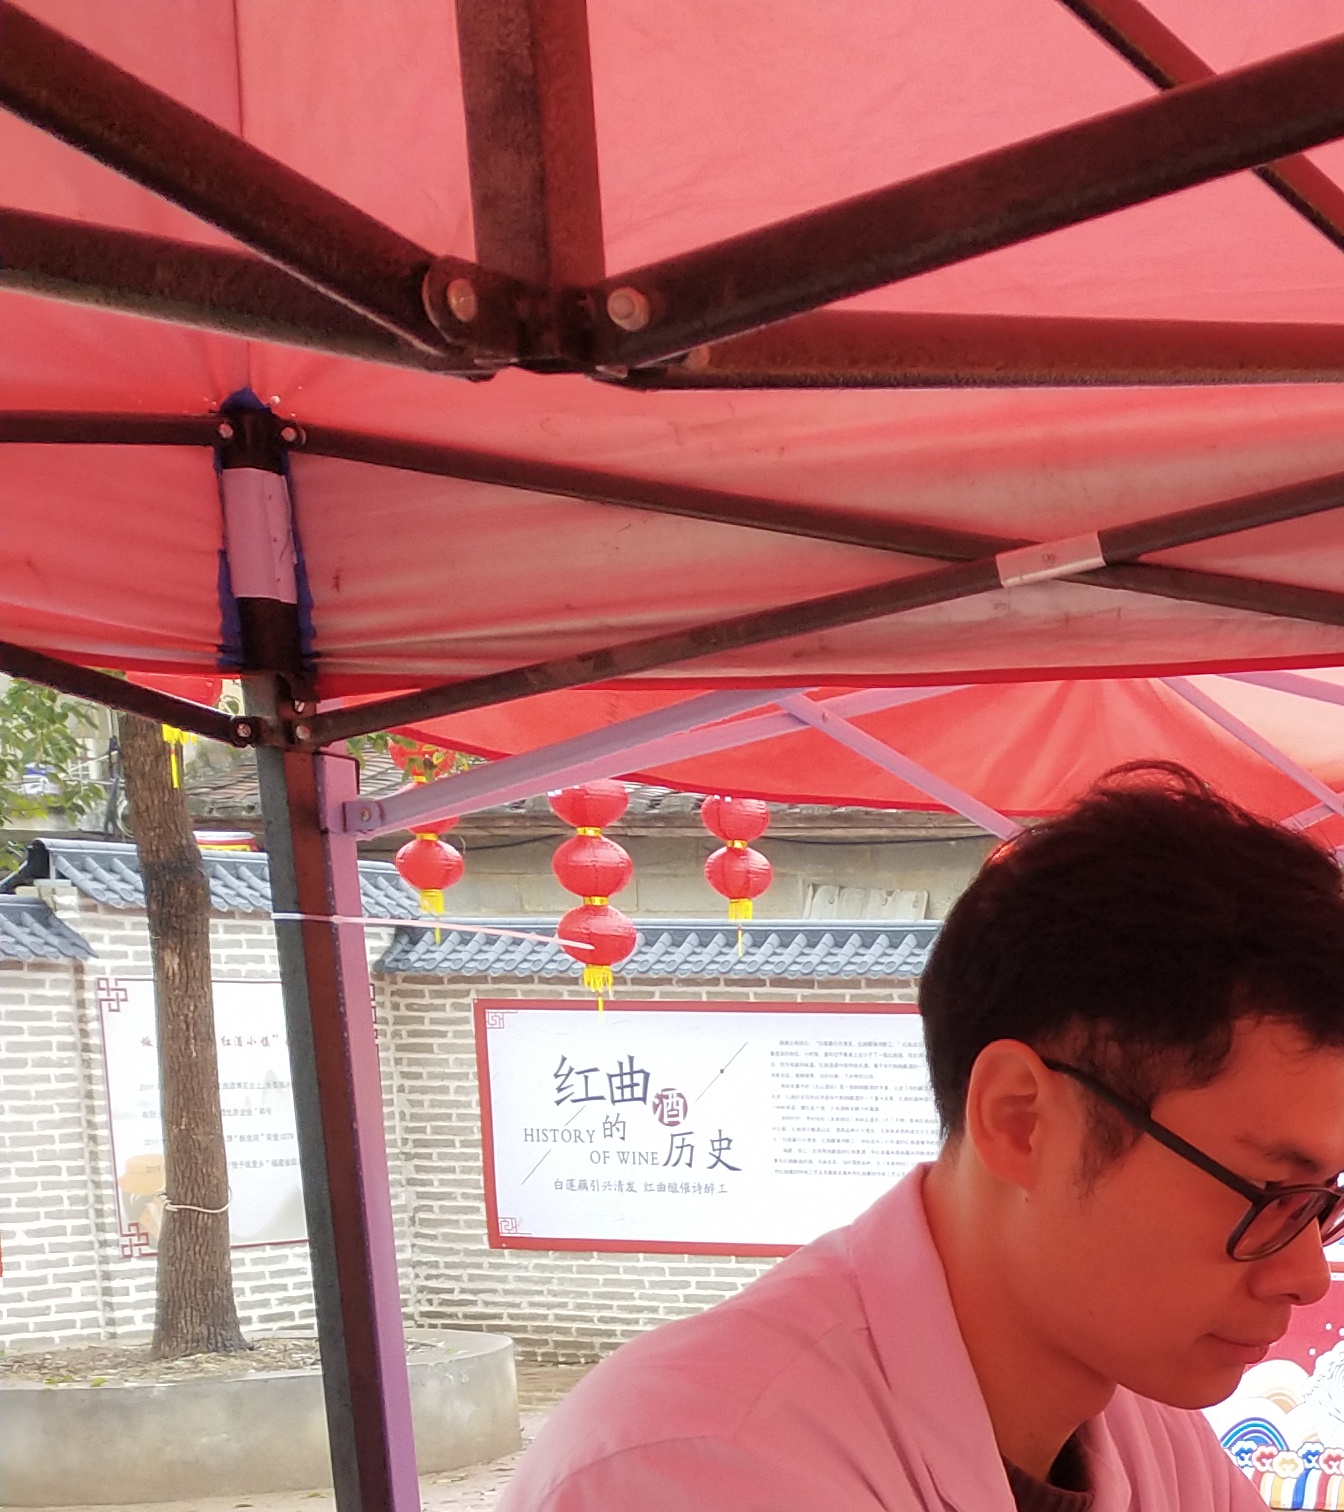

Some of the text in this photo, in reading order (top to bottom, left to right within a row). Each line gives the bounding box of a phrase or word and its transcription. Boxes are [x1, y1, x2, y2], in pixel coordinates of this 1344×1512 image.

[553, 1054, 651, 1107] 红曲
[653, 1088, 688, 1126] 酒
[523, 1127, 596, 1145] HISTORY
[602, 1114, 627, 1142] 的
[589, 1150, 660, 1167] OF WINE
[662, 1129, 743, 1172] 历史
